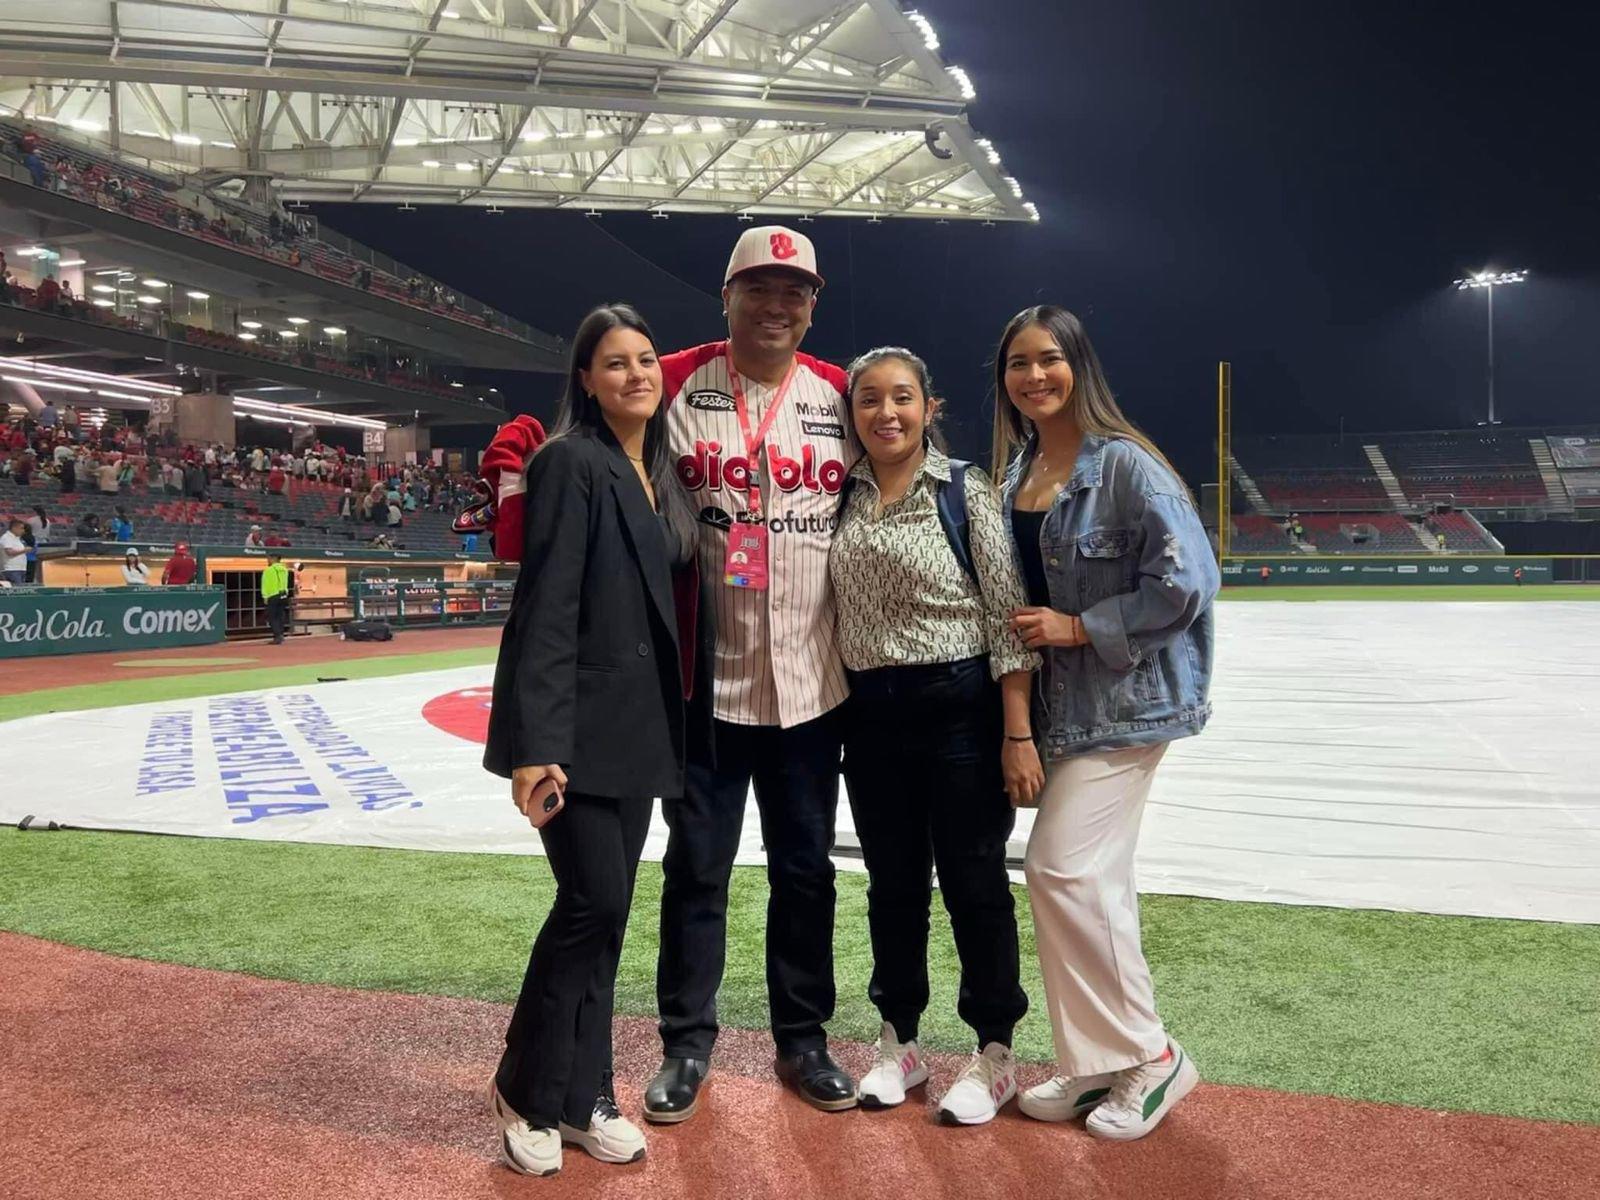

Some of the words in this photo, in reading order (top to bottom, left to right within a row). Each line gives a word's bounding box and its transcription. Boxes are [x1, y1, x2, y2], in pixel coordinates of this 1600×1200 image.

[152, 398, 170, 414] B3
[691, 392, 735, 411] Fester
[795, 402, 837, 417] Mobil
[804, 423, 841, 436] Lenovo
[365, 431, 381, 445] B4
[123, 601, 220, 635] Comex
[135, 763, 196, 796] CASA
